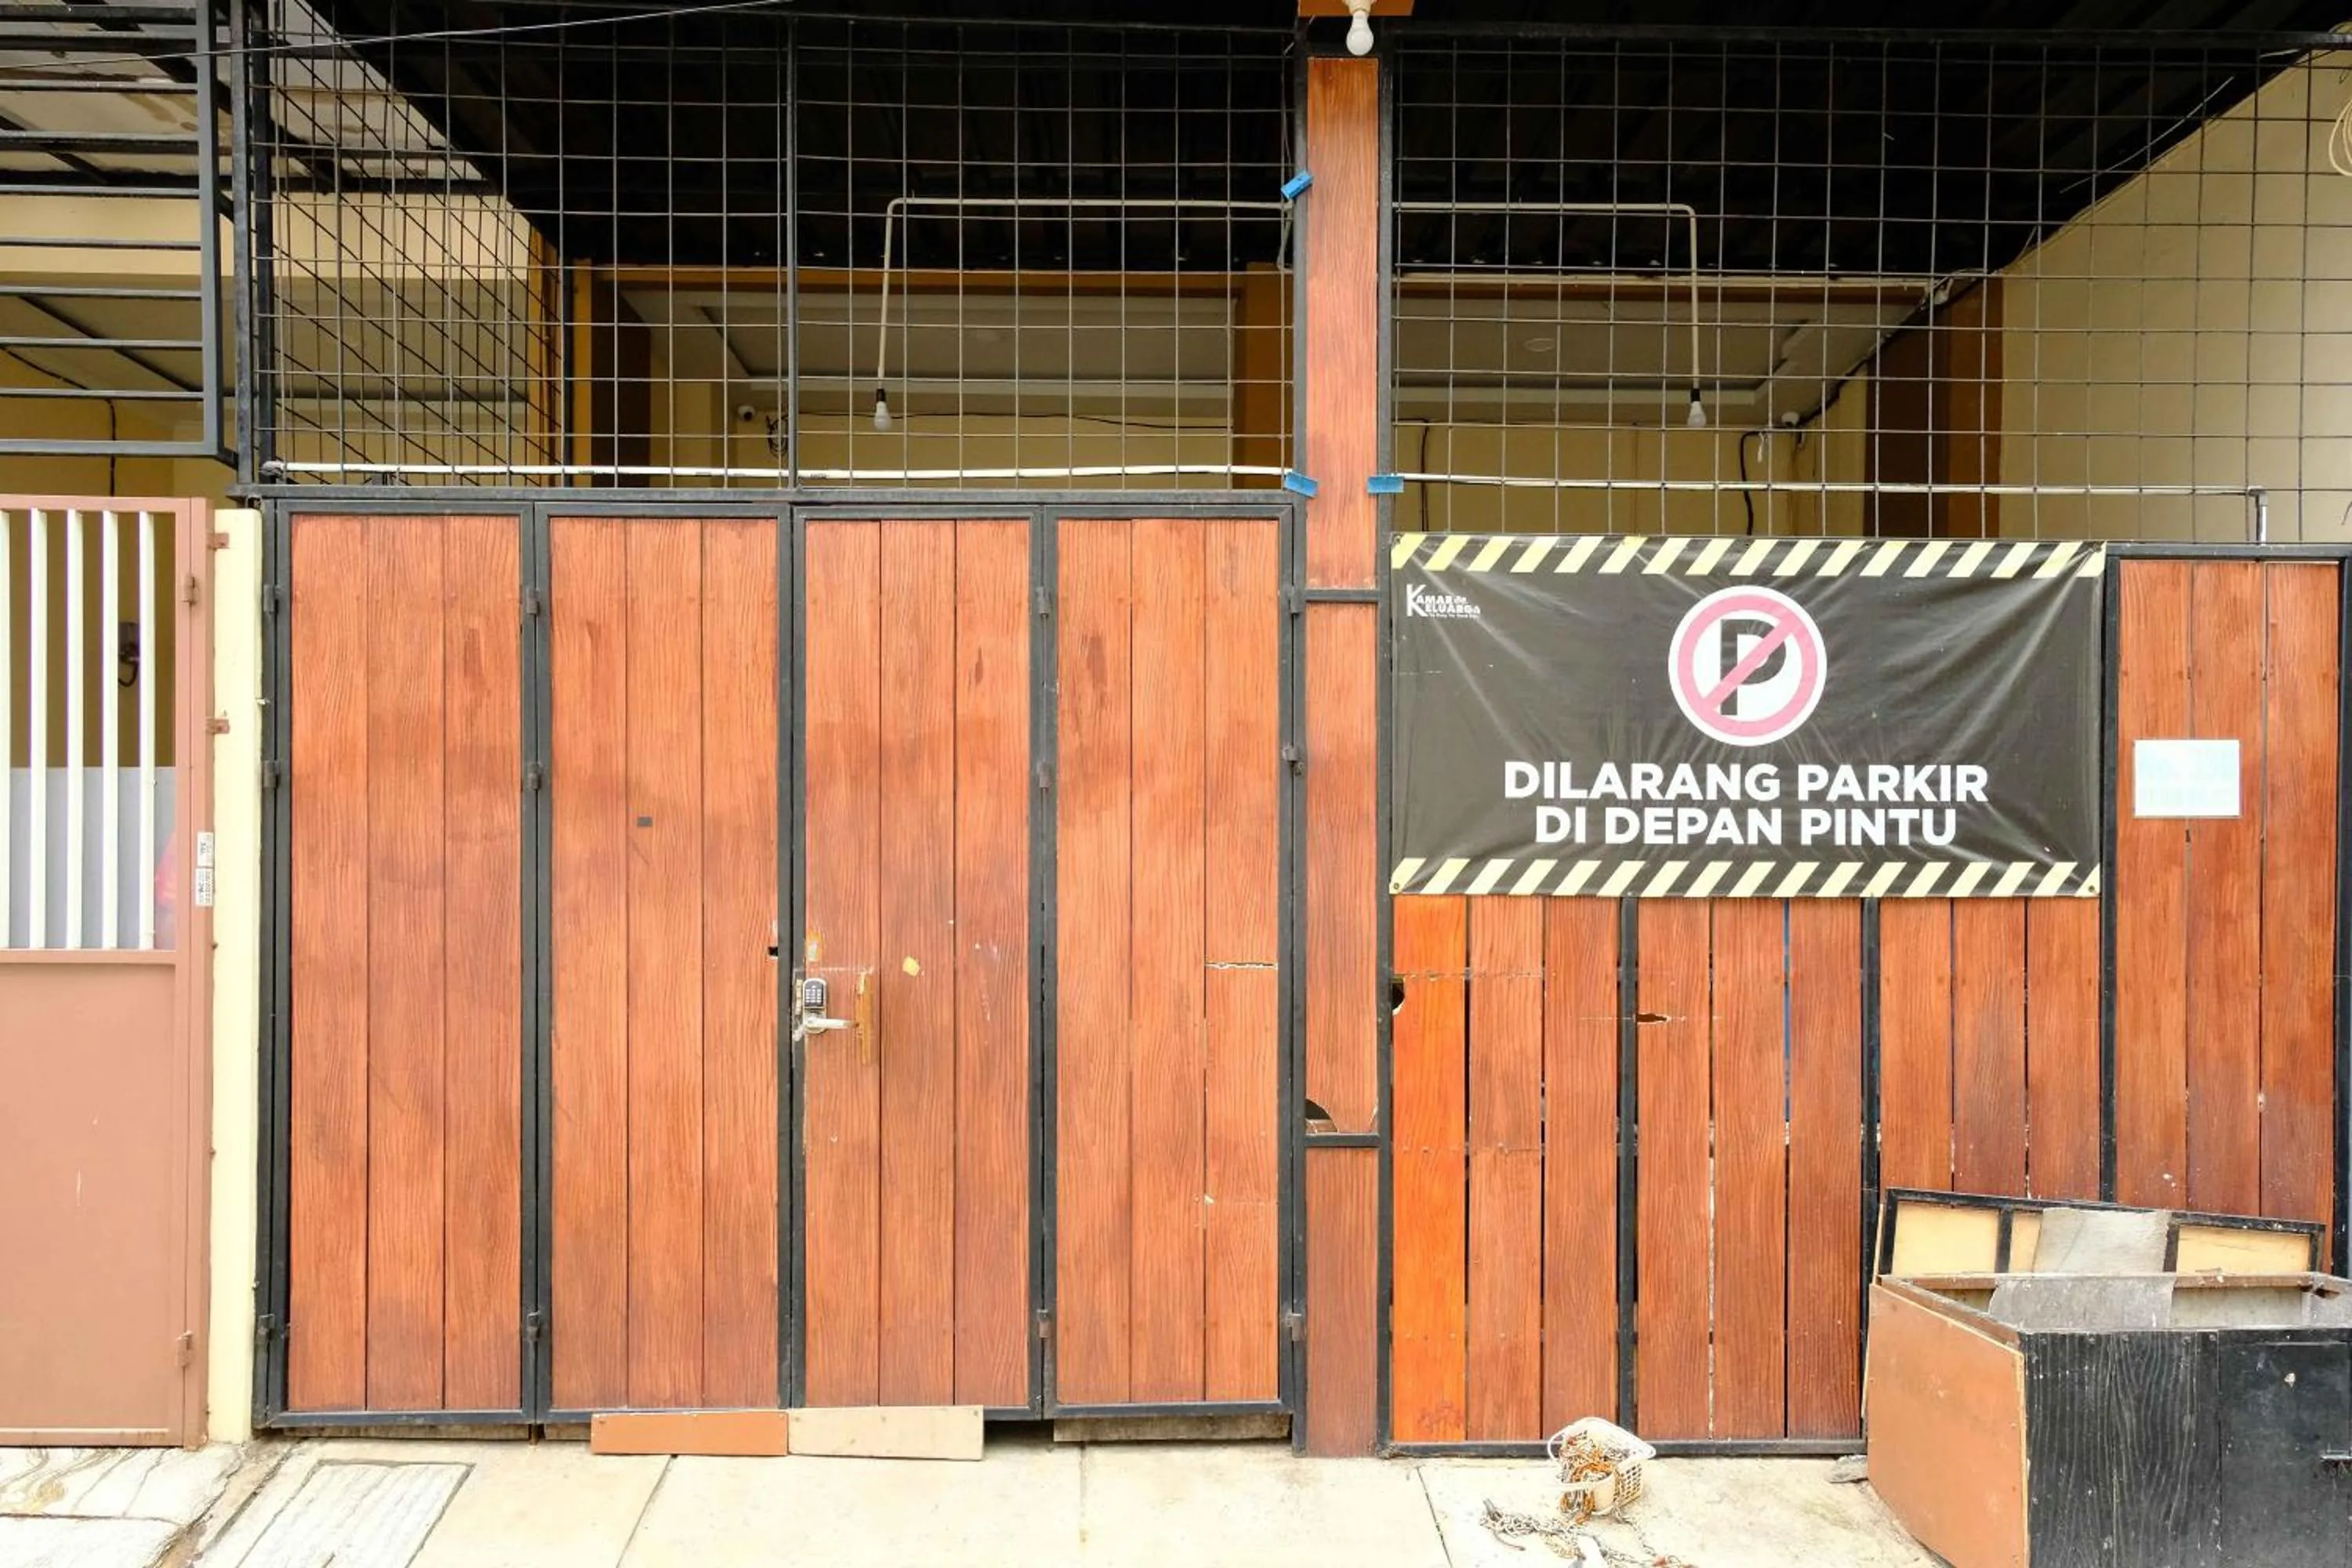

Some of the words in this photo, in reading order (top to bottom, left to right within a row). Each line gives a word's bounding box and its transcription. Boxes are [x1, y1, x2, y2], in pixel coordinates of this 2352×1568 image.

[1720, 619, 1787, 716] P
[1504, 761, 1780, 801] DILARANG
[1798, 764, 1988, 803] PARKIR
[1536, 805, 1586, 844] DI
[1605, 807, 1782, 845] DEPAN
[1801, 808, 1956, 846] PINTU
